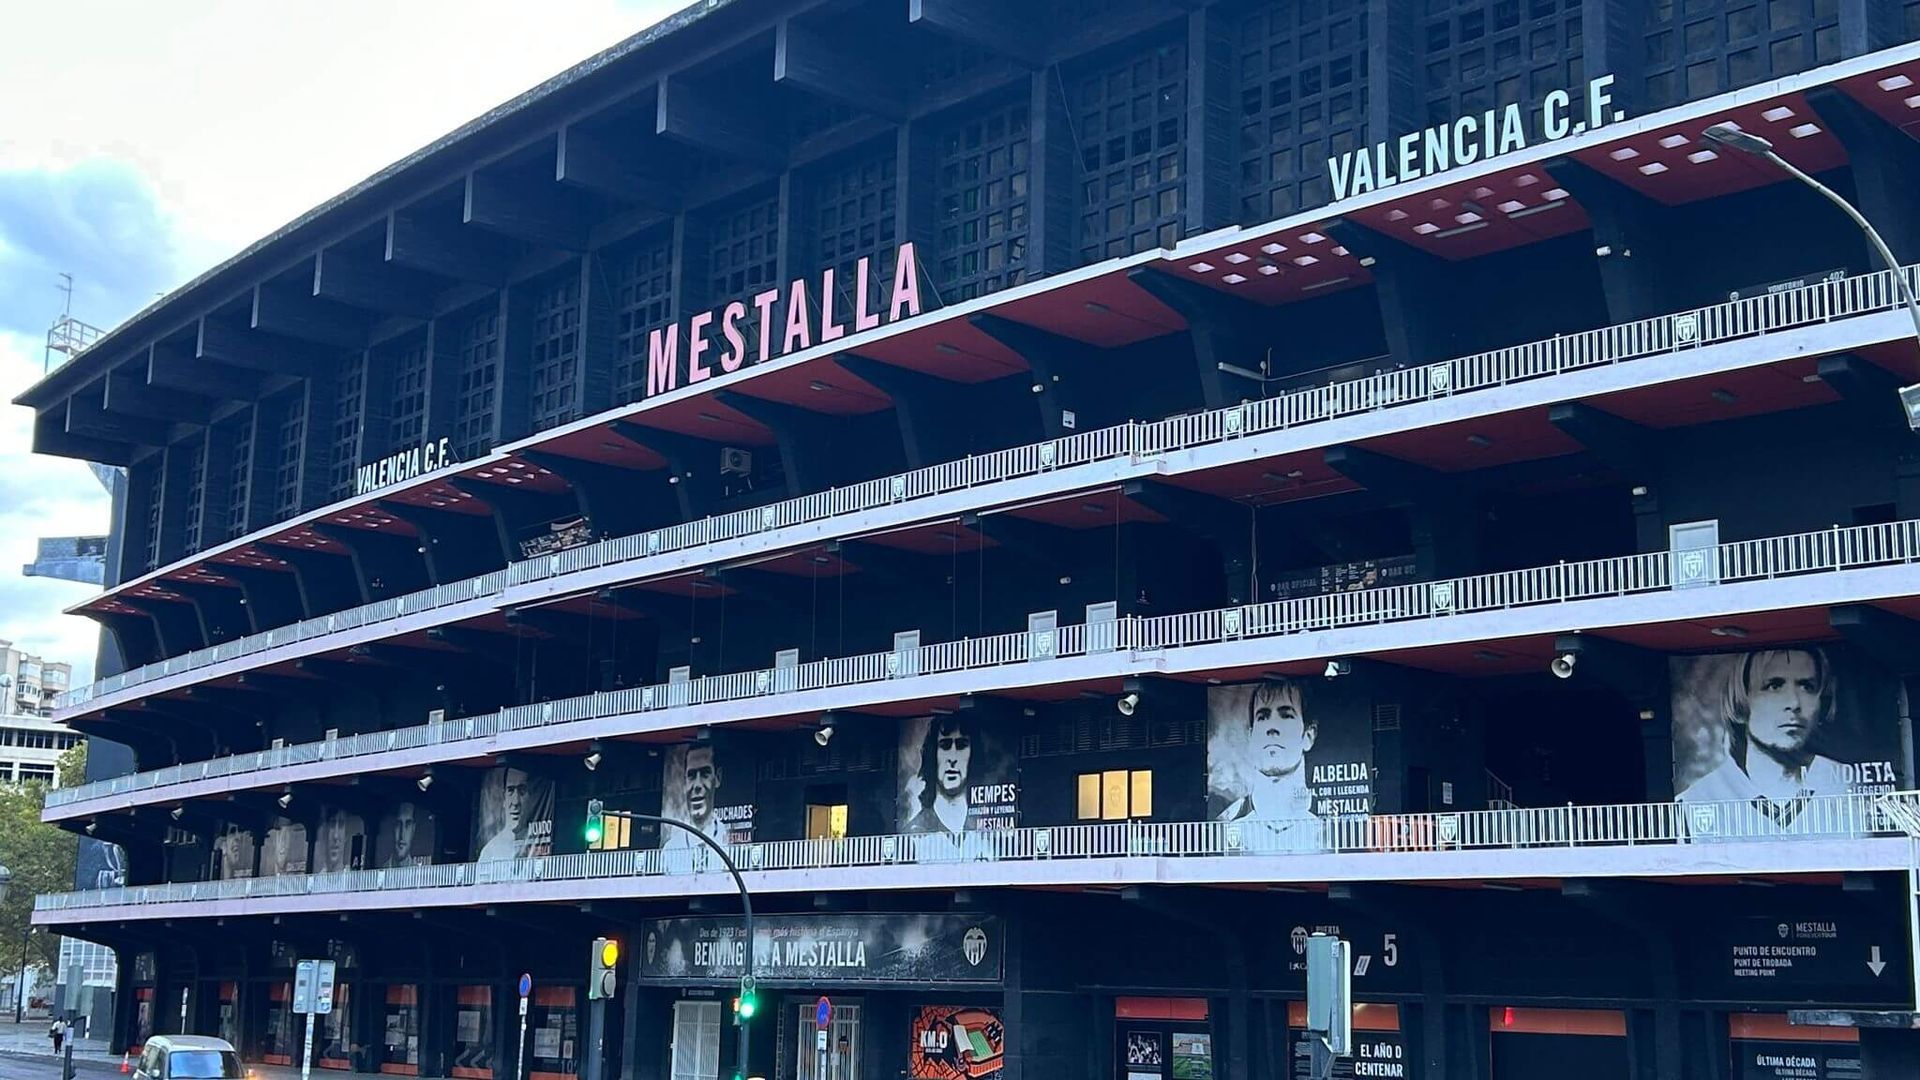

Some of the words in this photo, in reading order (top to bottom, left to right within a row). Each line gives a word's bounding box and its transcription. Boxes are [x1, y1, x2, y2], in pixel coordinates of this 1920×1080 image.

[1328, 103, 1526, 201] VALENCIA
[1543, 74, 1625, 140] C.F.
[647, 242, 921, 397] MESTALLA
[357, 447, 419, 495] VALENCIA
[424, 436, 450, 473] C.F.
[1312, 762, 1369, 784] ALBELDA
[970, 783, 1016, 805] KEMPES
[1337, 784, 1370, 795] LLEGENDA
[714, 804, 753, 821] PUCHADES
[1317, 798, 1369, 815] MESTALLA
[976, 816, 1015, 832] MESTALLA
[719, 926, 734, 938] 1923
[1796, 922, 1837, 932] MESTALLA
[771, 941, 781, 967] A
[785, 941, 866, 967] MESTALLA
[1383, 934, 1398, 966] 5
[1733, 946, 1758, 956] PUNTO
[1760, 946, 1770, 956] DE
[1771, 946, 1817, 956] ENCUENTRO
[1733, 958, 1751, 967] PUNT
[1752, 958, 1761, 967] DE
[1360, 1044, 1371, 1058] EL
[1373, 1042, 1392, 1058] AÑO
[1756, 1054, 1784, 1067] ÚLTIMA
[1785, 1056, 1816, 1068] DÉCADA
[1355, 1062, 1403, 1078] CENTENAR
